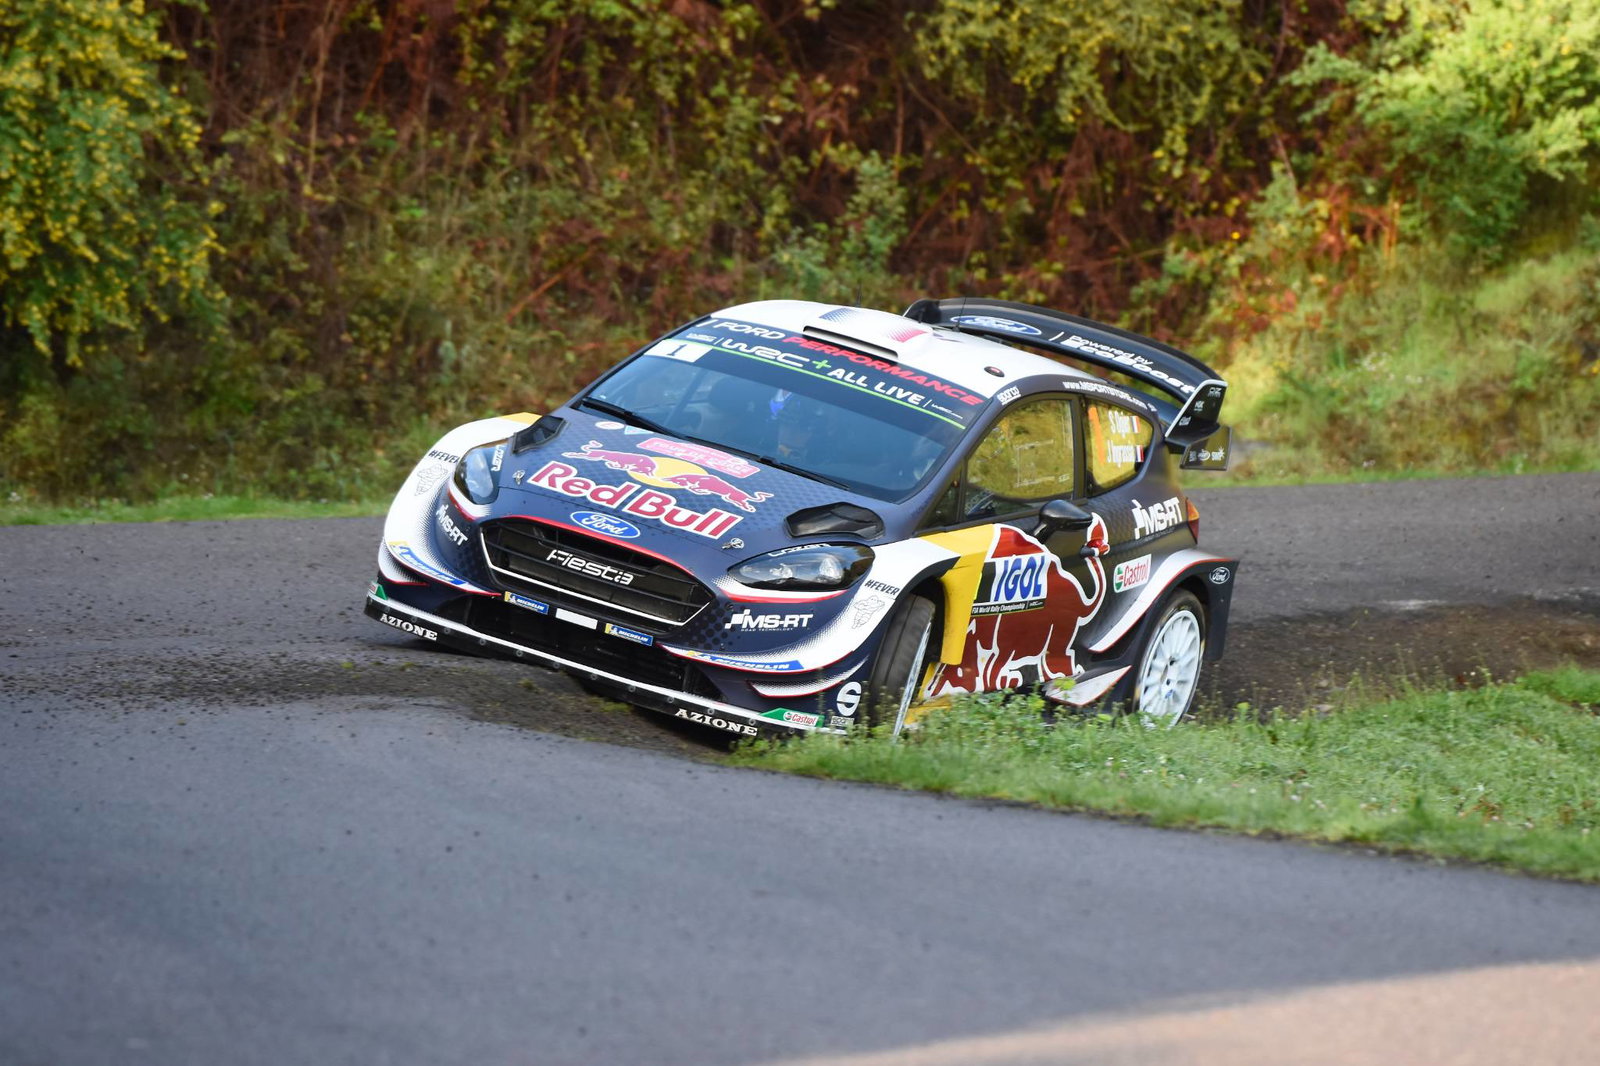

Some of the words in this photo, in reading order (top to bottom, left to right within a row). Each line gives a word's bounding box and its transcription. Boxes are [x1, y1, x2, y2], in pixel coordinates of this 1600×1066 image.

[665, 343, 688, 357] 1
[713, 320, 786, 339] FORD
[781, 337, 985, 406] PERFORMANCE
[1070, 335, 1136, 358] Powered
[1135, 356, 1153, 366] by
[1060, 339, 1196, 394] EcoBoost
[827, 368, 868, 388] ALL
[874, 381, 926, 406] LIVE
[528, 461, 641, 509] Red
[622, 489, 744, 540] Bull
[580, 513, 626, 536] Ford
[546, 549, 635, 586] Fiesta
[993, 556, 1046, 602] IGOL
[1123, 559, 1149, 588] Castrol
[864, 579, 901, 596] #FEVER
[516, 598, 545, 611] MICHELIN
[380, 613, 438, 641] AZIONE
[741, 612, 814, 629] MS-RT
[618, 630, 649, 643] MICHELIN
[675, 708, 758, 737] AZIONE
[791, 713, 817, 726] Castrol
